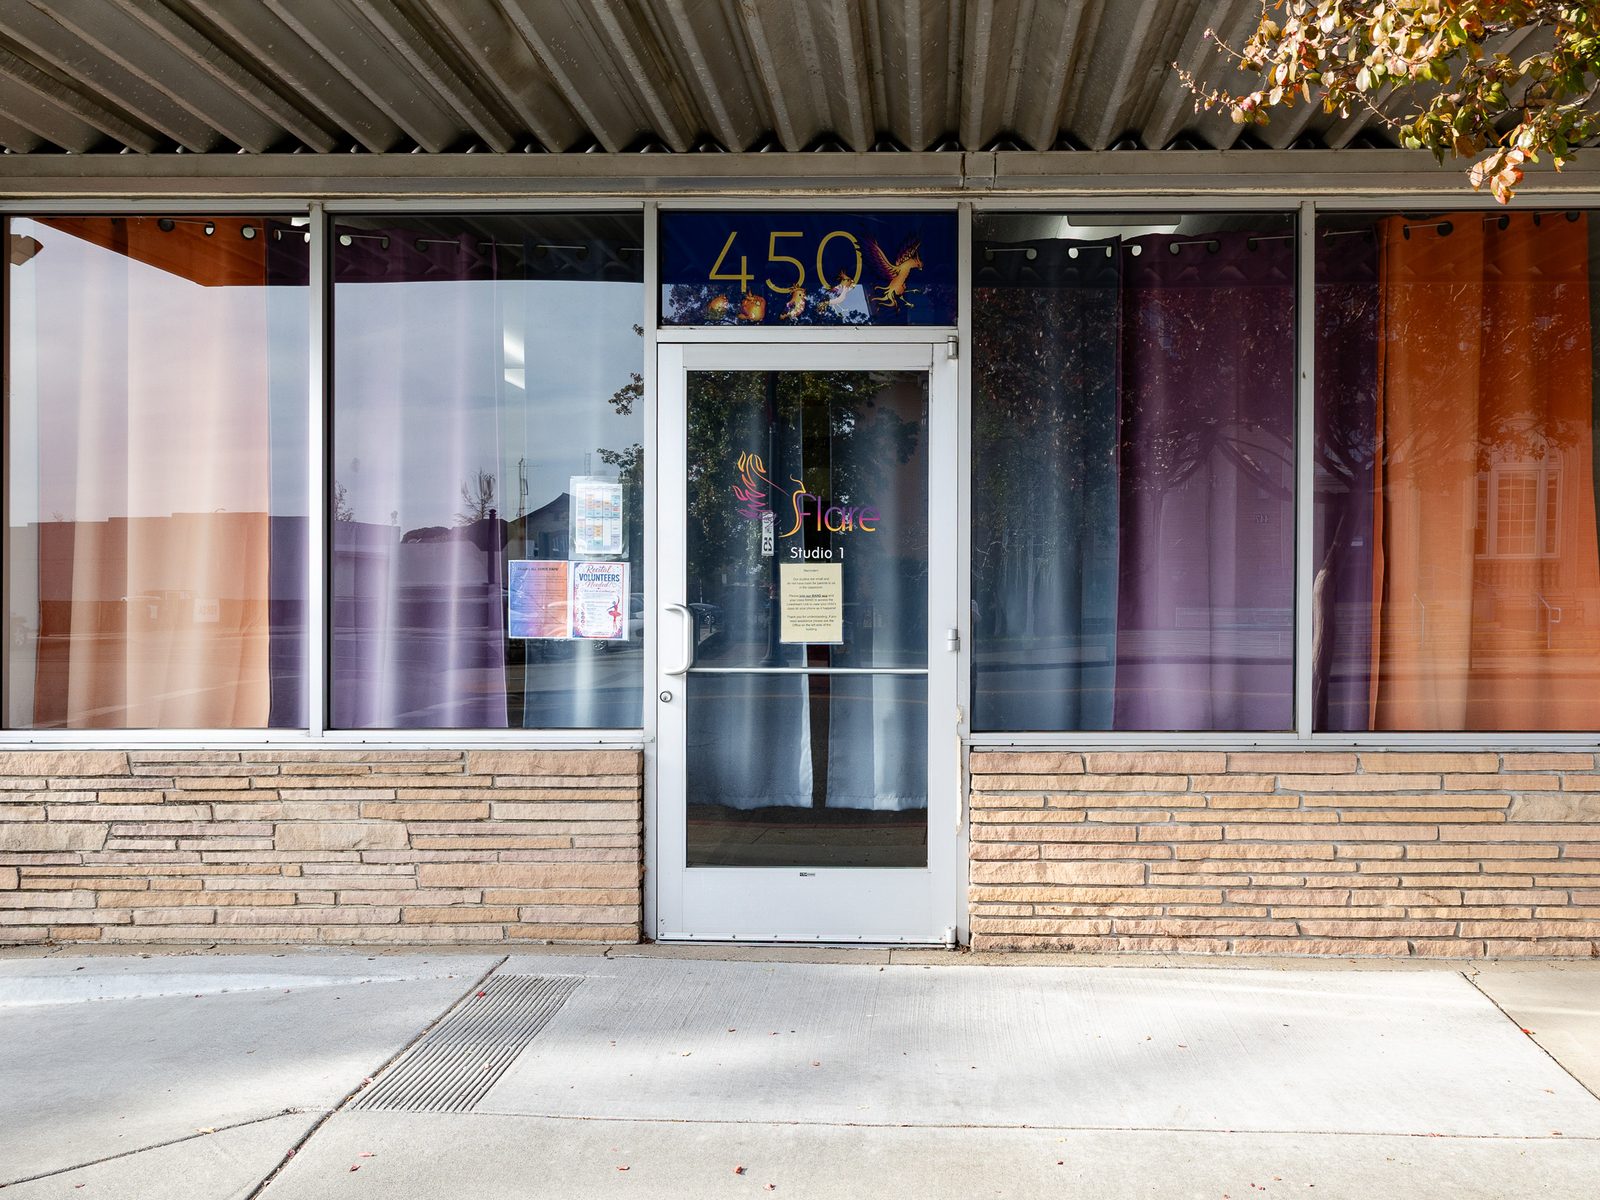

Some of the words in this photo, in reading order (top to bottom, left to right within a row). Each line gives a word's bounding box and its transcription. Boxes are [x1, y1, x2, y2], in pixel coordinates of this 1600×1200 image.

[709, 230, 863, 294] 450
[790, 546, 833, 559] Studio
[839, 547, 844, 559] 1
[586, 565, 612, 573] Recital
[579, 573, 620, 582] VOLUNTEERS
